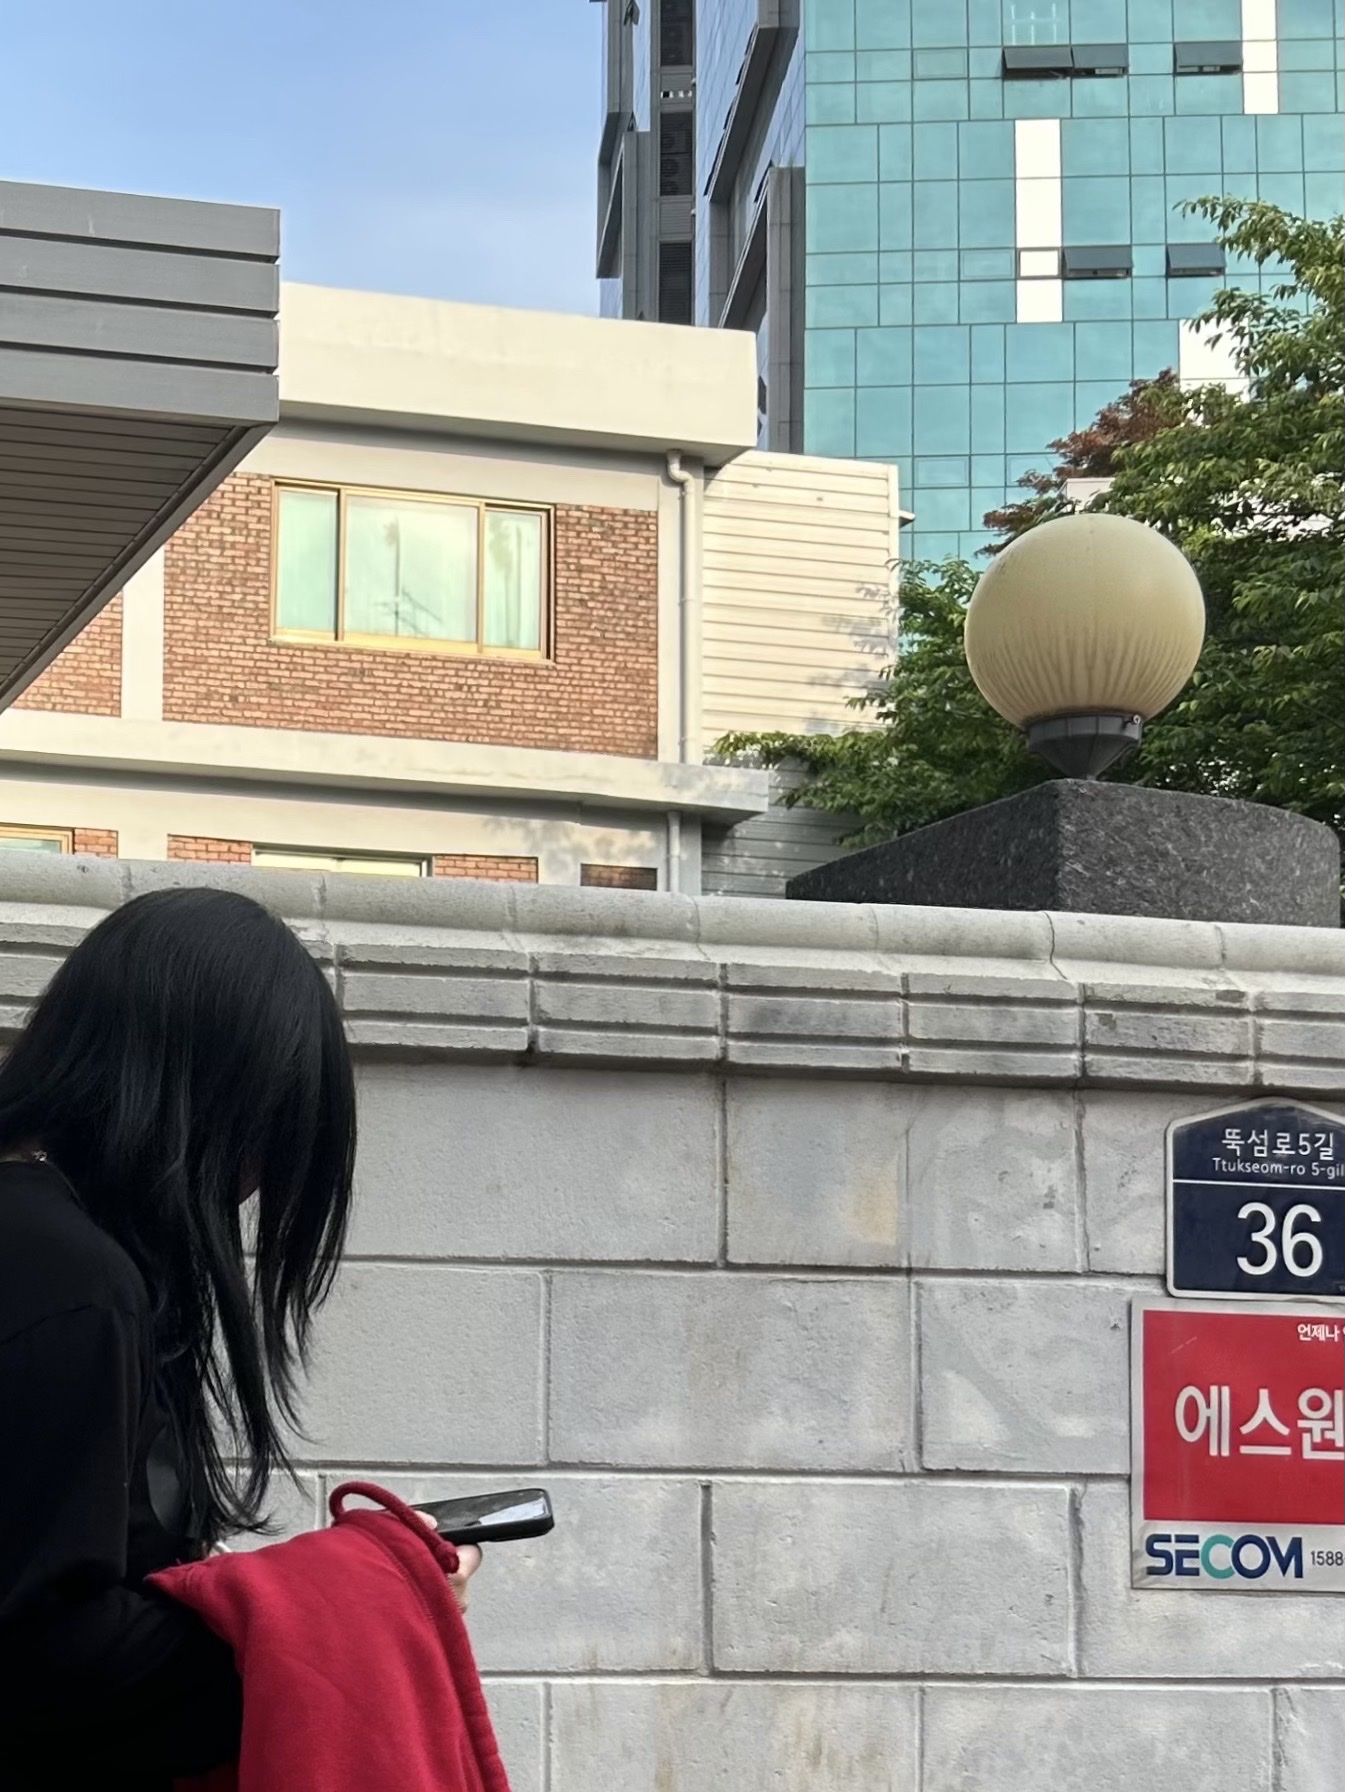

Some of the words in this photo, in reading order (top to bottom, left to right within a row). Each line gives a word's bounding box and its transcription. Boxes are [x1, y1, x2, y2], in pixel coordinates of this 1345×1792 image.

[1222, 1128, 1334, 1160] 뚝섬로5길
[1212, 1157, 1306, 1175] Ttukseom-ro
[1311, 1162, 1344, 1179] 5-gil
[1236, 1202, 1323, 1277] 36
[1297, 1323, 1340, 1342] 언제나
[1174, 1385, 1345, 1460] 에스원
[1145, 1533, 1304, 1580] SECOM
